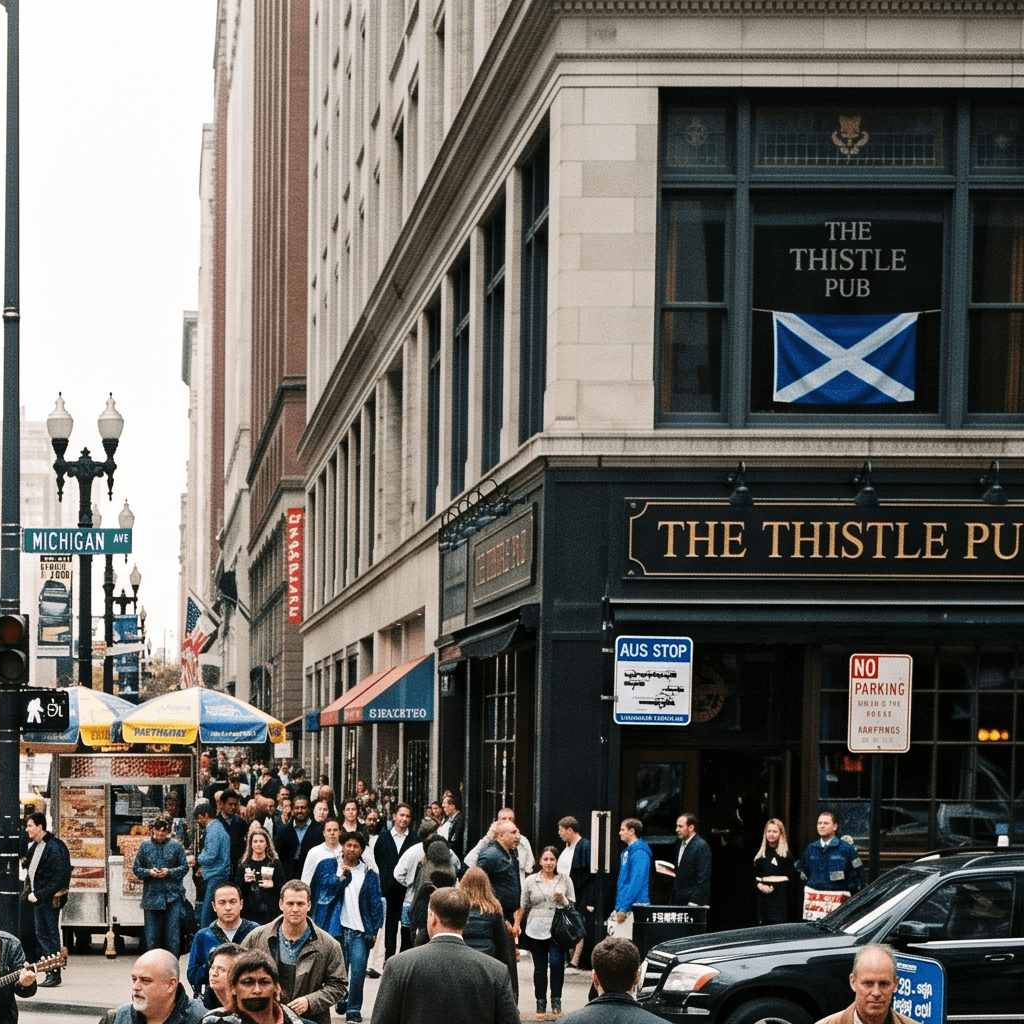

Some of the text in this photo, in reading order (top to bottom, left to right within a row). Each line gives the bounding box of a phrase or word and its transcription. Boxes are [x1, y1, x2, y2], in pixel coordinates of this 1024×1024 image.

[825, 221, 872, 241] THE
[789, 248, 907, 271] THISTLE
[825, 278, 871, 298] PUB
[32, 531, 129, 551] MICHIGAN AVE
[657, 521, 747, 559] THE
[762, 521, 949, 560] THISTLE
[619, 643, 687, 658] AUS STOP
[854, 658, 876, 677] NO
[855, 682, 905, 696] PARKING
